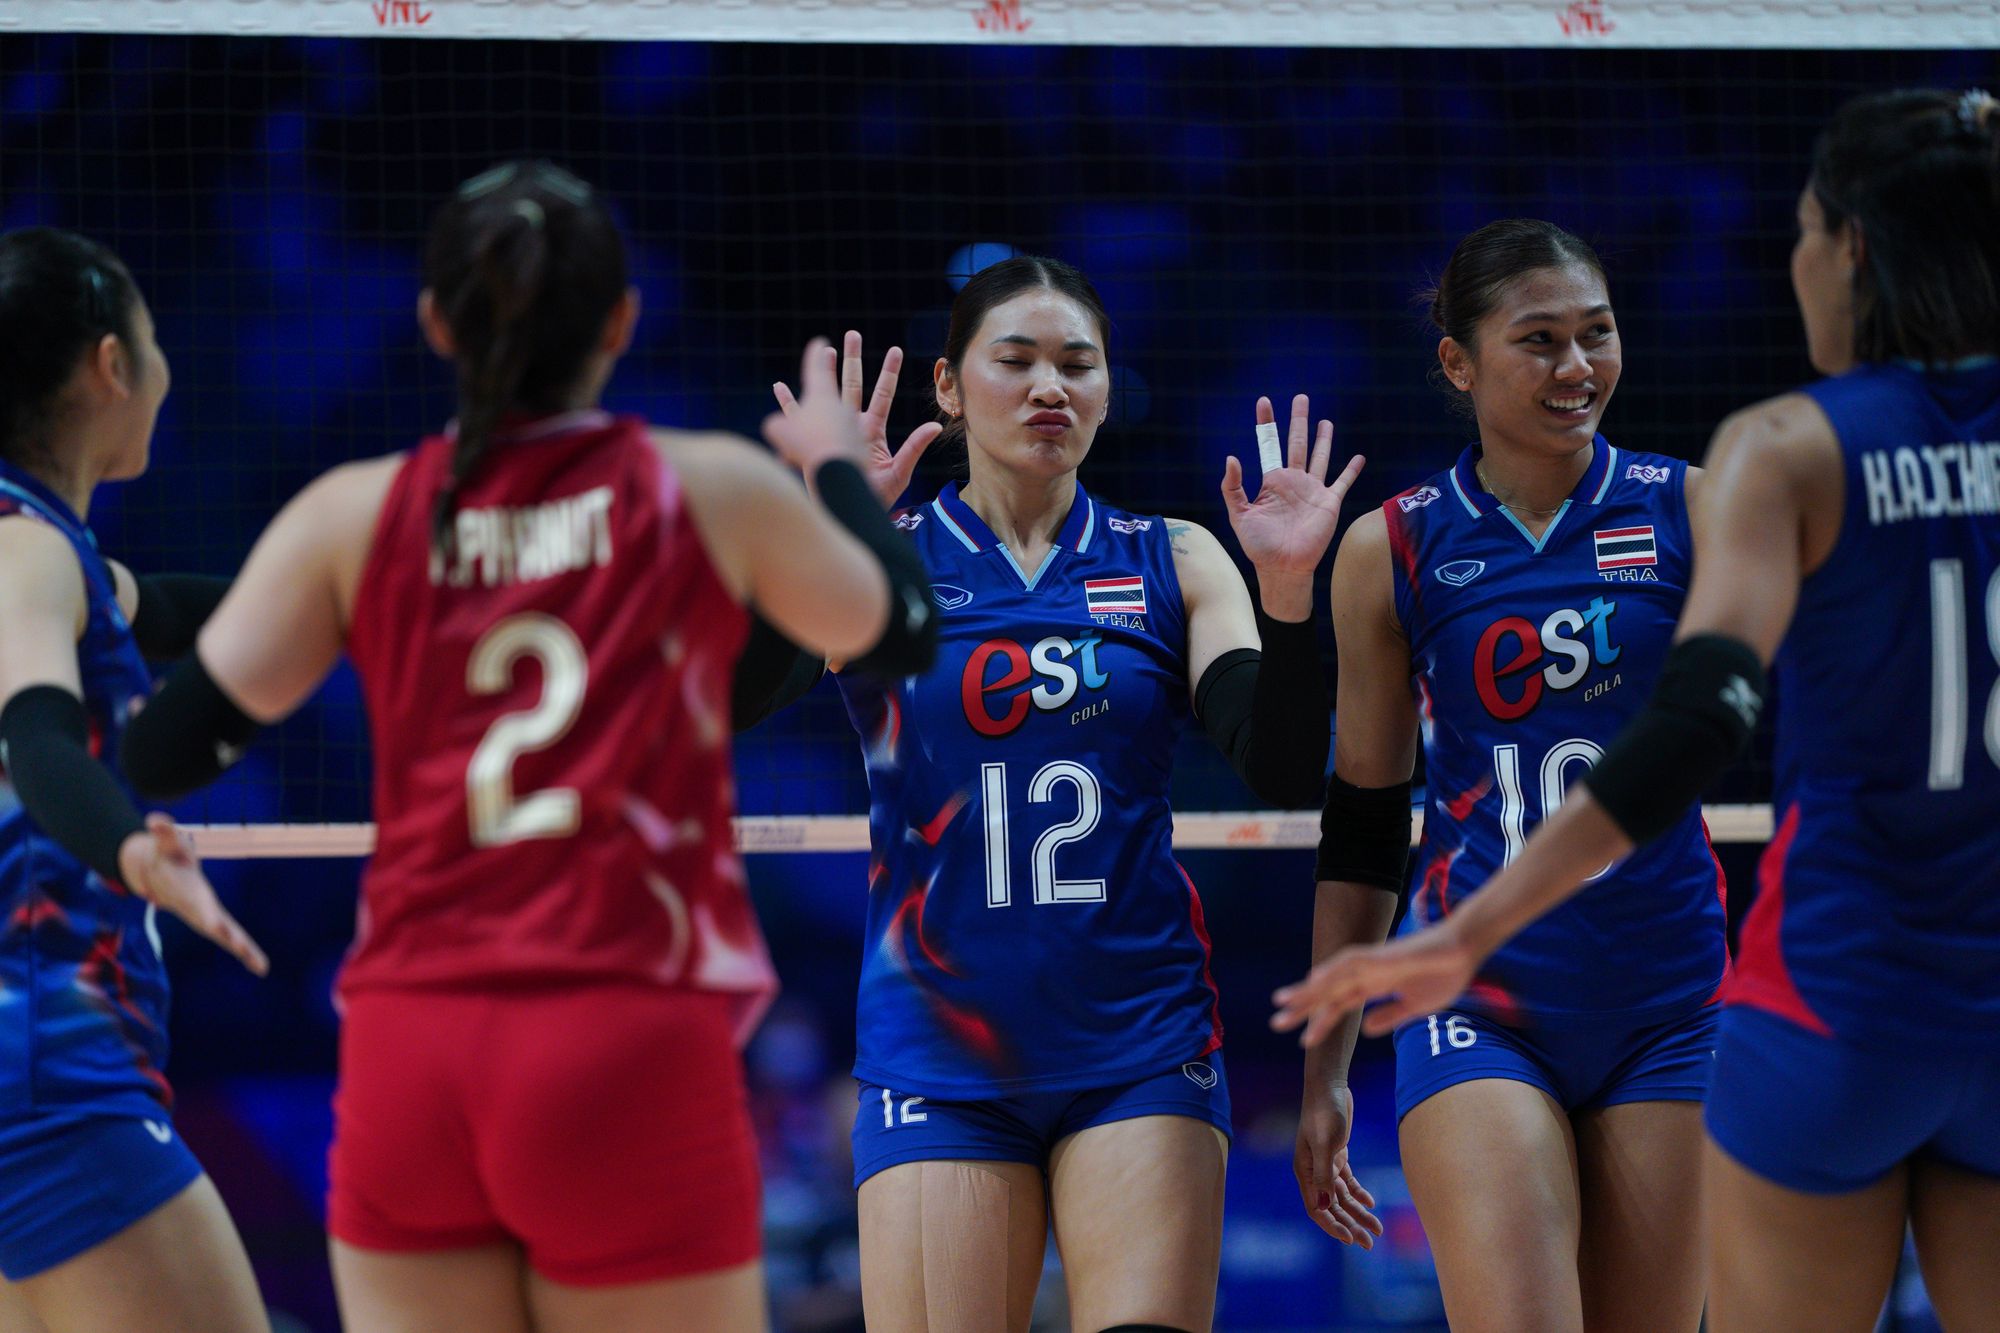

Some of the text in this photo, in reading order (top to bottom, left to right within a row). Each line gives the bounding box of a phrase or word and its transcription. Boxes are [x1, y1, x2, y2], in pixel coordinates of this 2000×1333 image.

[1599, 567, 1659, 582] THA
[1090, 613, 1146, 631] THA
[1473, 595, 1622, 719] est
[961, 628, 1109, 736] est
[1584, 673, 1622, 702] COLA
[465, 611, 588, 848] 2
[1071, 698, 1109, 726] COLA
[981, 760, 1107, 908] 12
[1427, 1014, 1477, 1057] 16
